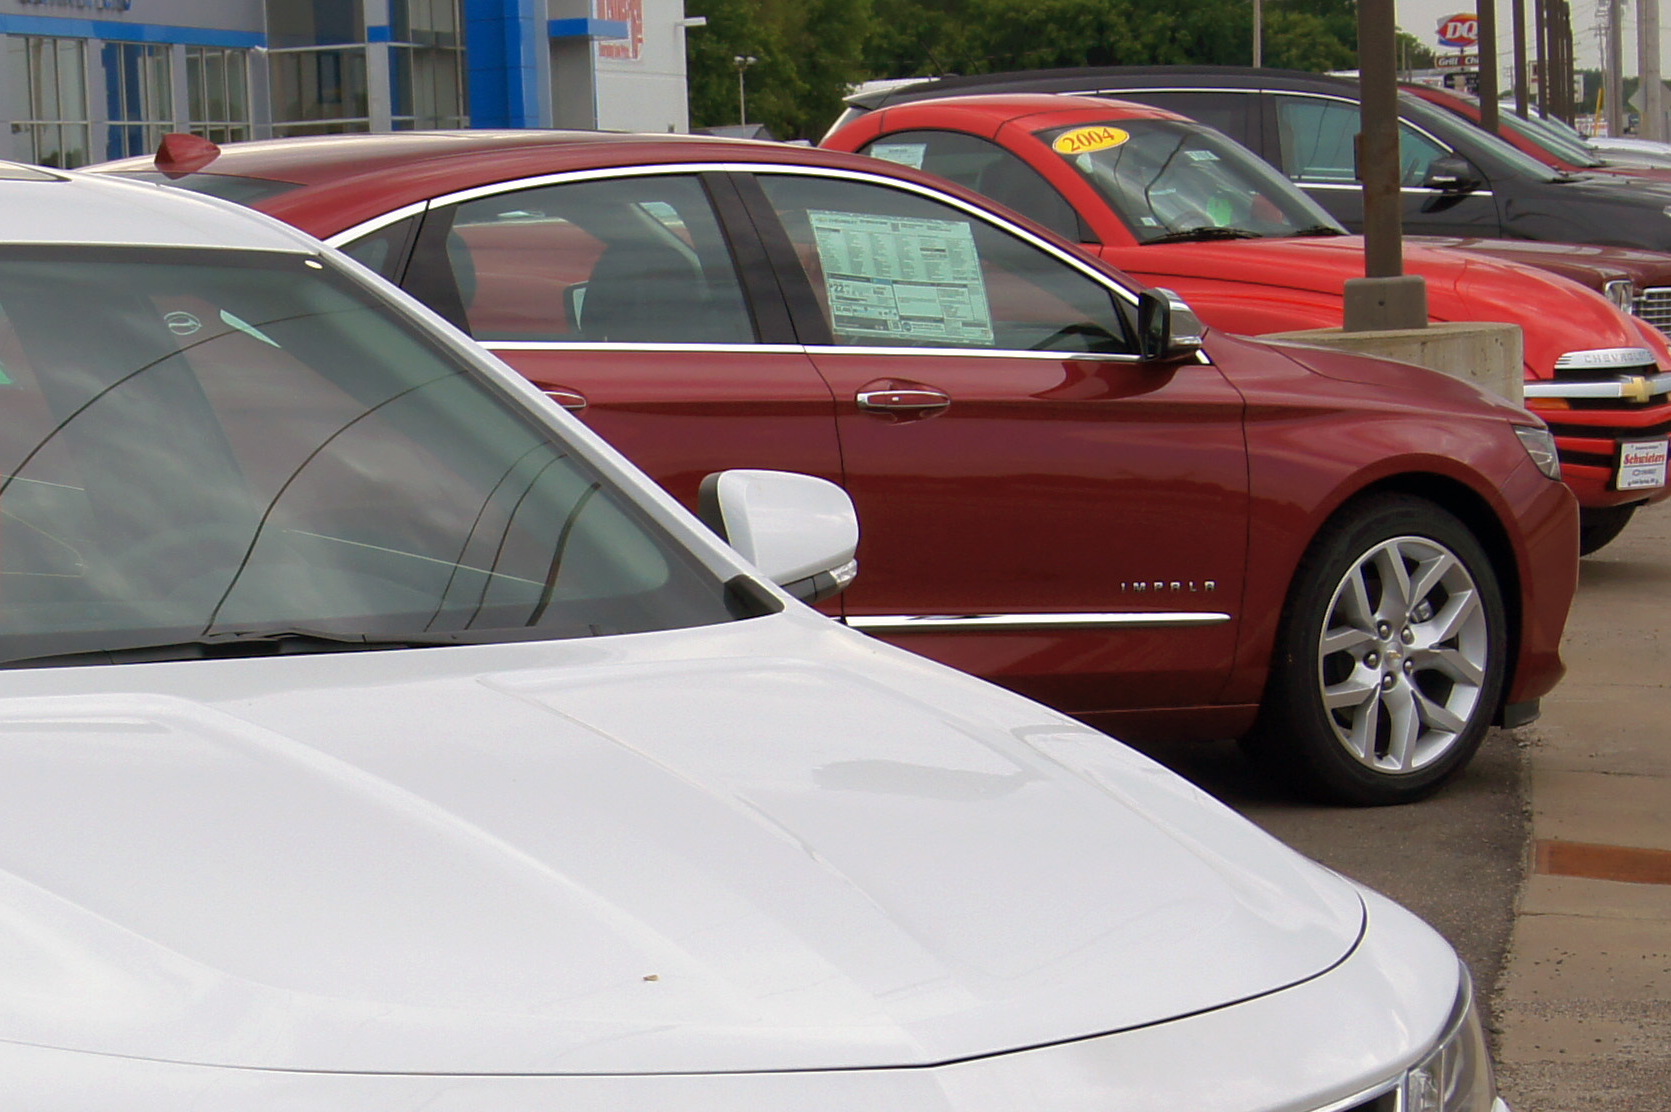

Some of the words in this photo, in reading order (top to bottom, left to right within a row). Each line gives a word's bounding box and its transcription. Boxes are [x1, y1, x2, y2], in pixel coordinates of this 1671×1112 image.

[1445, 21, 1478, 39] DQ
[1063, 127, 1115, 152] 2004
[1120, 581, 1216, 593] IMPALA
